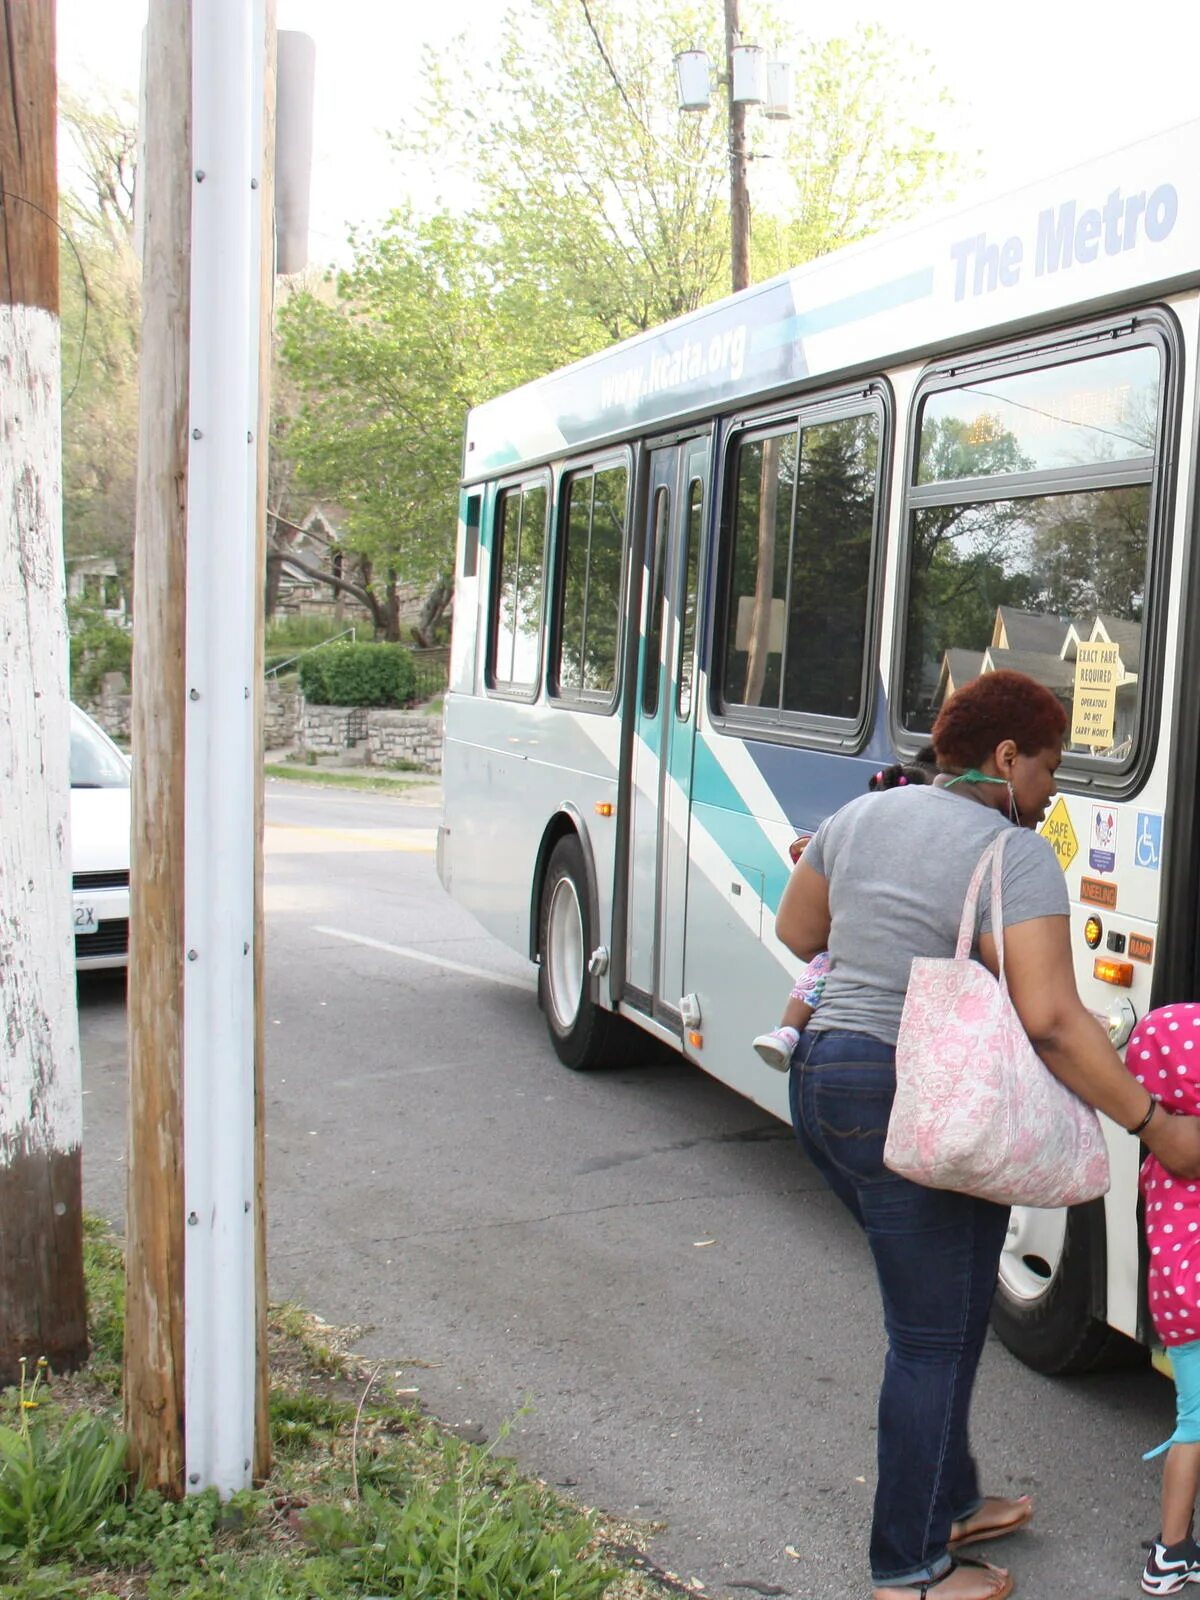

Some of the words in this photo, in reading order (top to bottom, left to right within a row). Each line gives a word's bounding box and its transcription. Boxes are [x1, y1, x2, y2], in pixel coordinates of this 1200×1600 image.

[950, 232, 1023, 301] The
[1035, 181, 1178, 277] Metro
[1079, 649, 1098, 663] EXACT
[1100, 649, 1117, 664] FARE
[1080, 669, 1112, 684] REQUIRED
[1080, 698, 1108, 709] OPERATORS
[1083, 712, 1091, 721] DO
[1092, 713, 1102, 722] NOT
[1075, 726, 1090, 736] CARRY
[1091, 727, 1109, 737] MONEY
[1049, 820, 1069, 839] SAFE
[1082, 883, 1115, 905] KNEELING
[1130, 940, 1151, 956] RAMP
